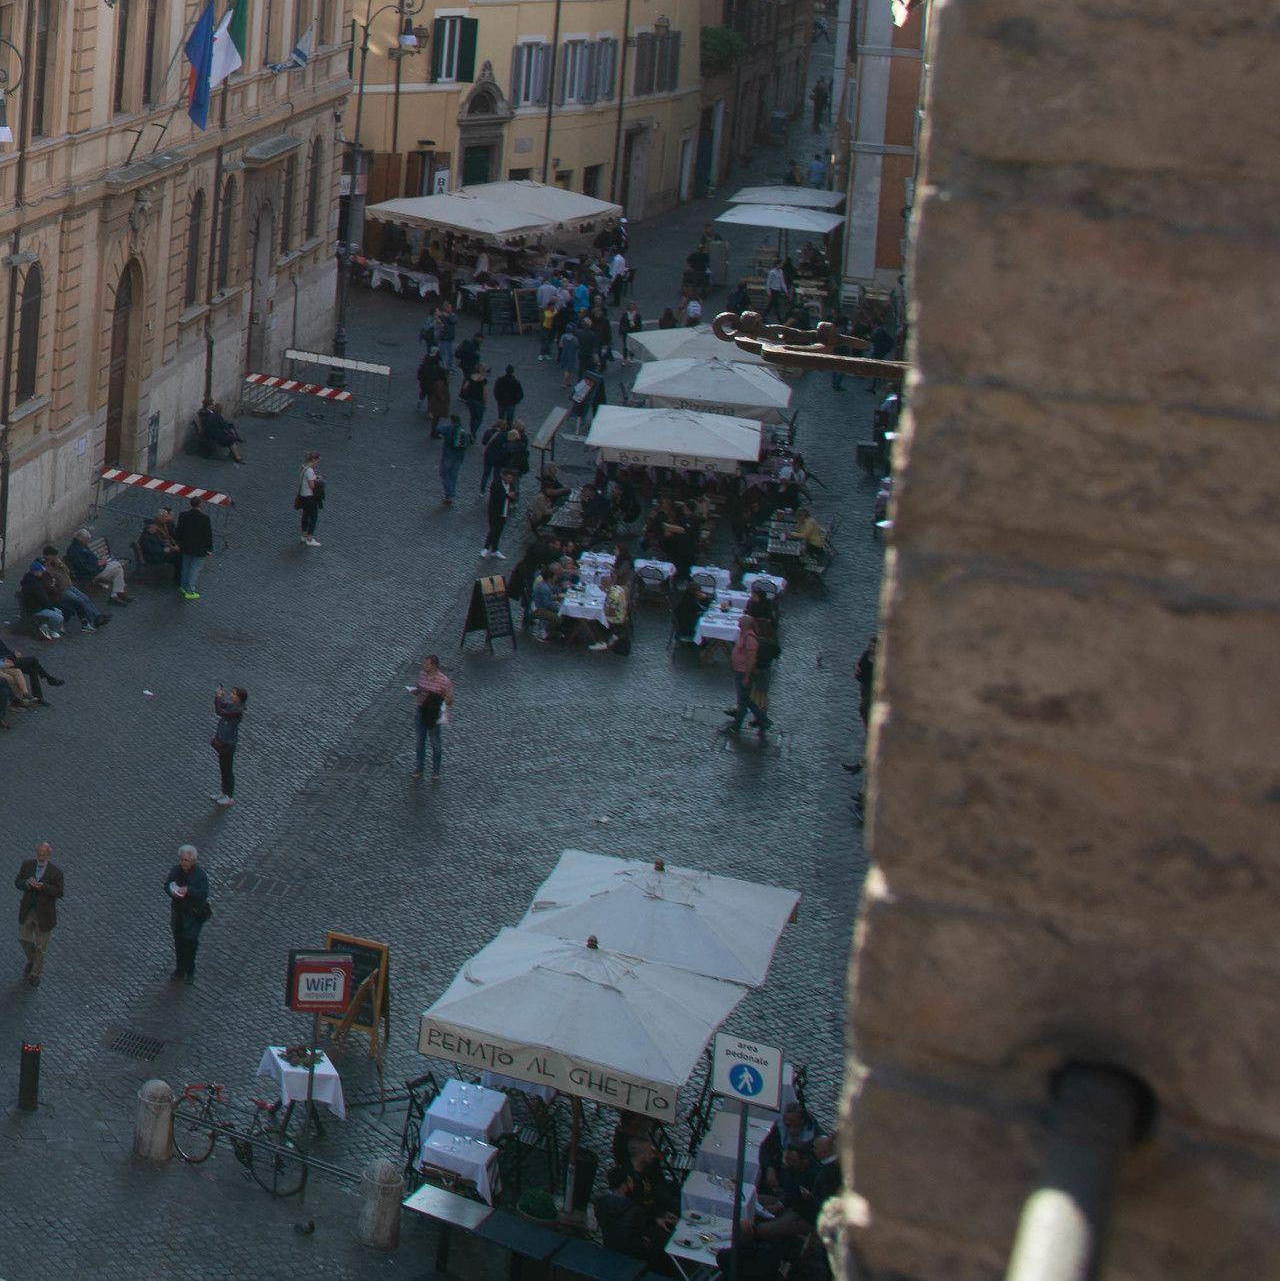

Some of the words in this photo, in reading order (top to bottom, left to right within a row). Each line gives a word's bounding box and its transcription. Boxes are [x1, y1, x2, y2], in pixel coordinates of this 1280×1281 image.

[306, 977, 337, 991] WiFi
[737, 1042, 758, 1053] area
[427, 1028, 514, 1067] RENATO
[526, 1057, 556, 1078] AL
[569, 1068, 669, 1111] GHETTO
